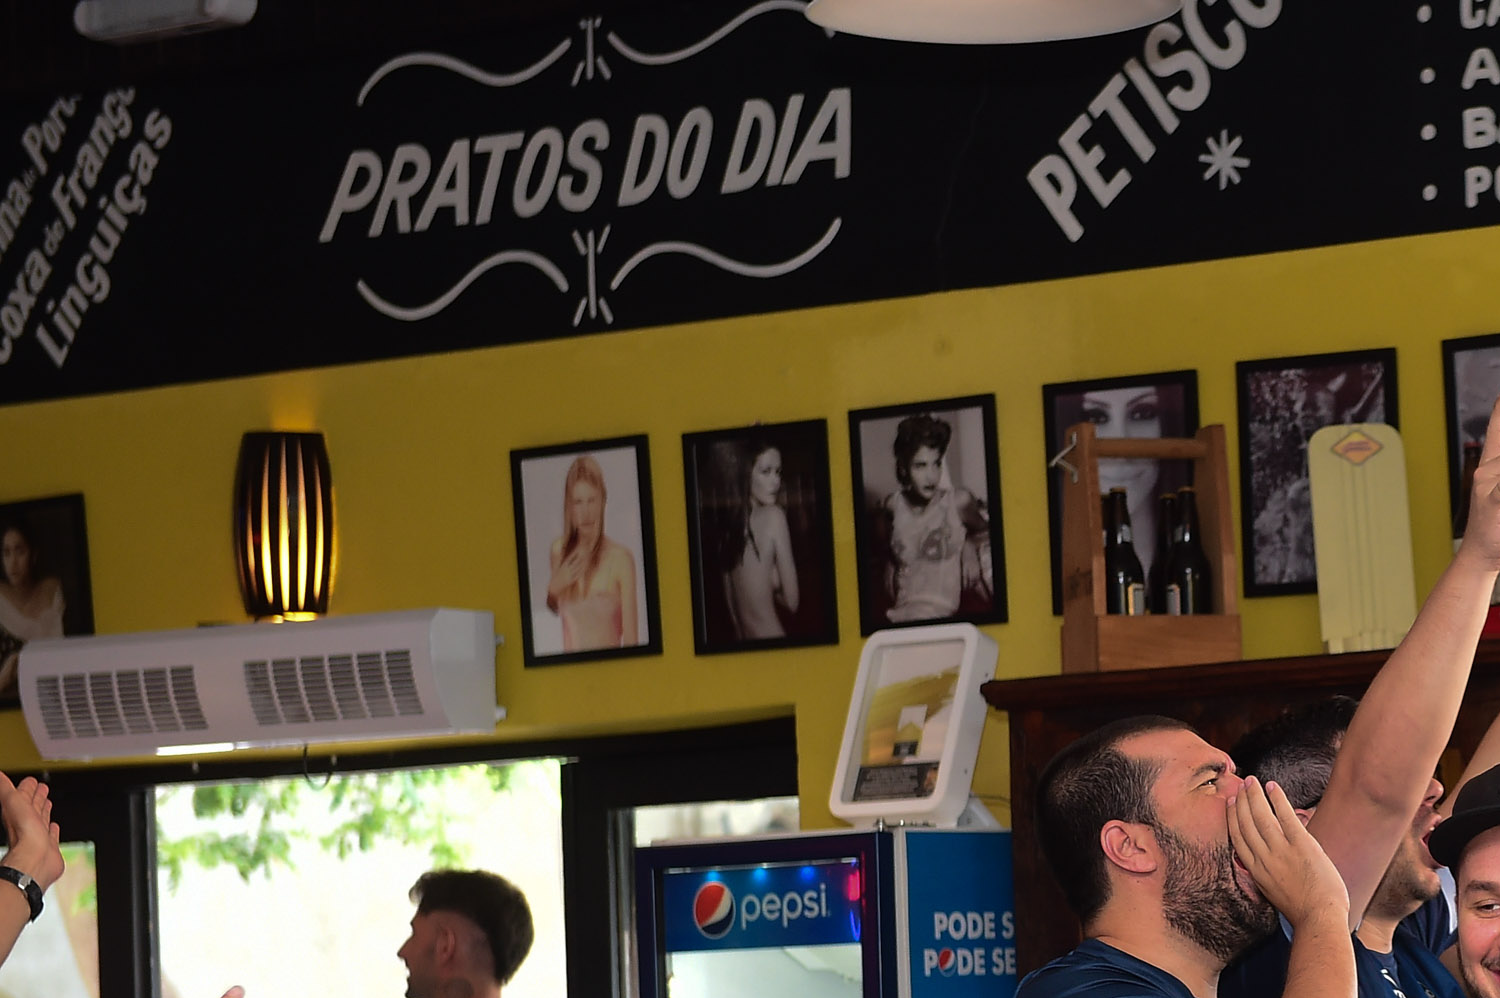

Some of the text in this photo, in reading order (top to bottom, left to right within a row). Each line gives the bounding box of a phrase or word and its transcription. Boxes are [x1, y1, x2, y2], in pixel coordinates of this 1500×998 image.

[319, 88, 852, 243] PRATOS DO DIA
[36, 109, 172, 369] Linguiças
[741, 884, 827, 930] pepsi
[934, 911, 996, 940] PODE
